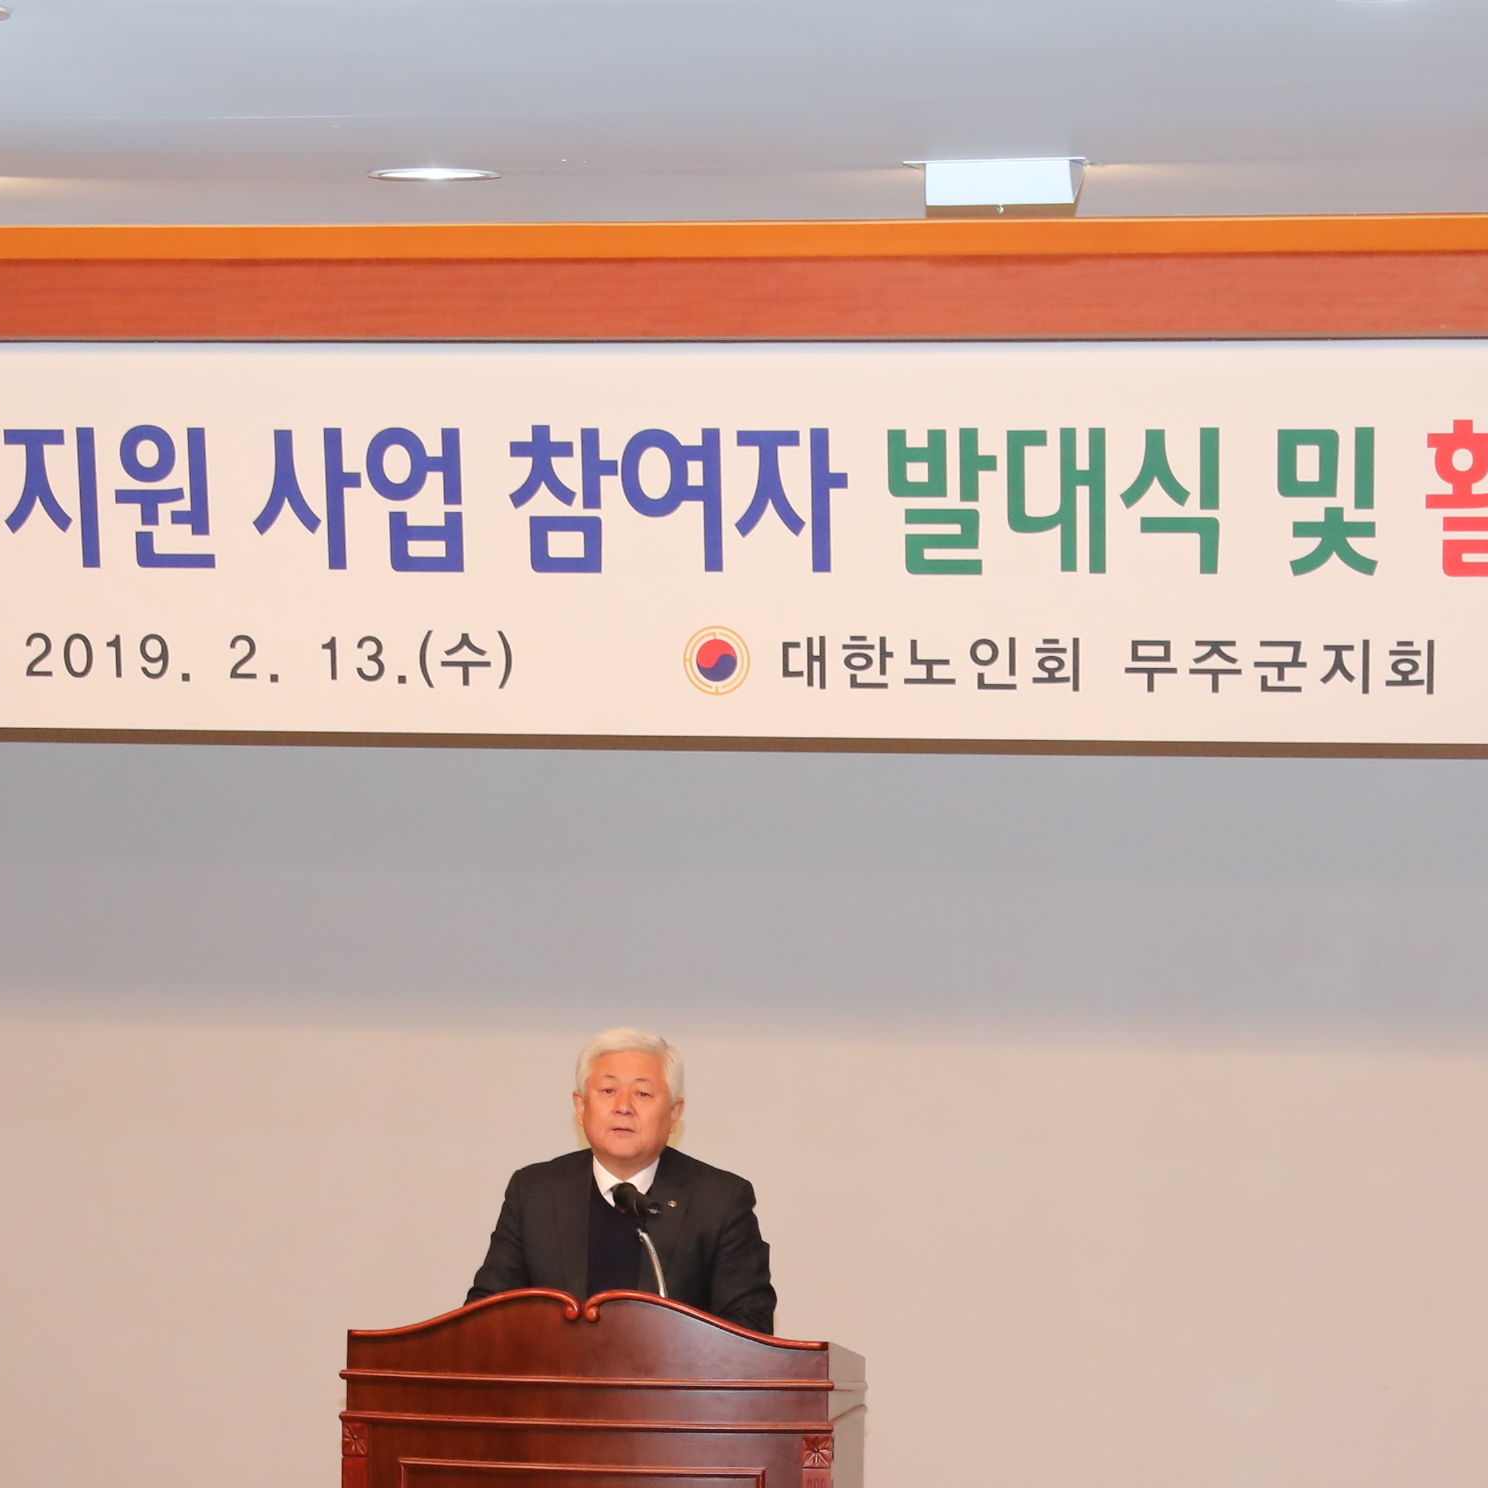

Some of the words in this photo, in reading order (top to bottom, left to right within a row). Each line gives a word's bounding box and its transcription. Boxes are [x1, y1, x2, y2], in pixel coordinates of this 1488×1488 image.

[252, 426, 465, 574] 사업
[508, 424, 849, 575] 참여자
[886, 426, 1221, 576] 발대식
[1275, 426, 1379, 577] 및
[24, 632, 192, 684] 2019.
[228, 635, 281, 684] 2.
[320, 629, 514, 691] 13.(수)
[781, 634, 1082, 693] 대한노인회
[1123, 638, 1437, 696] 무주군지회
